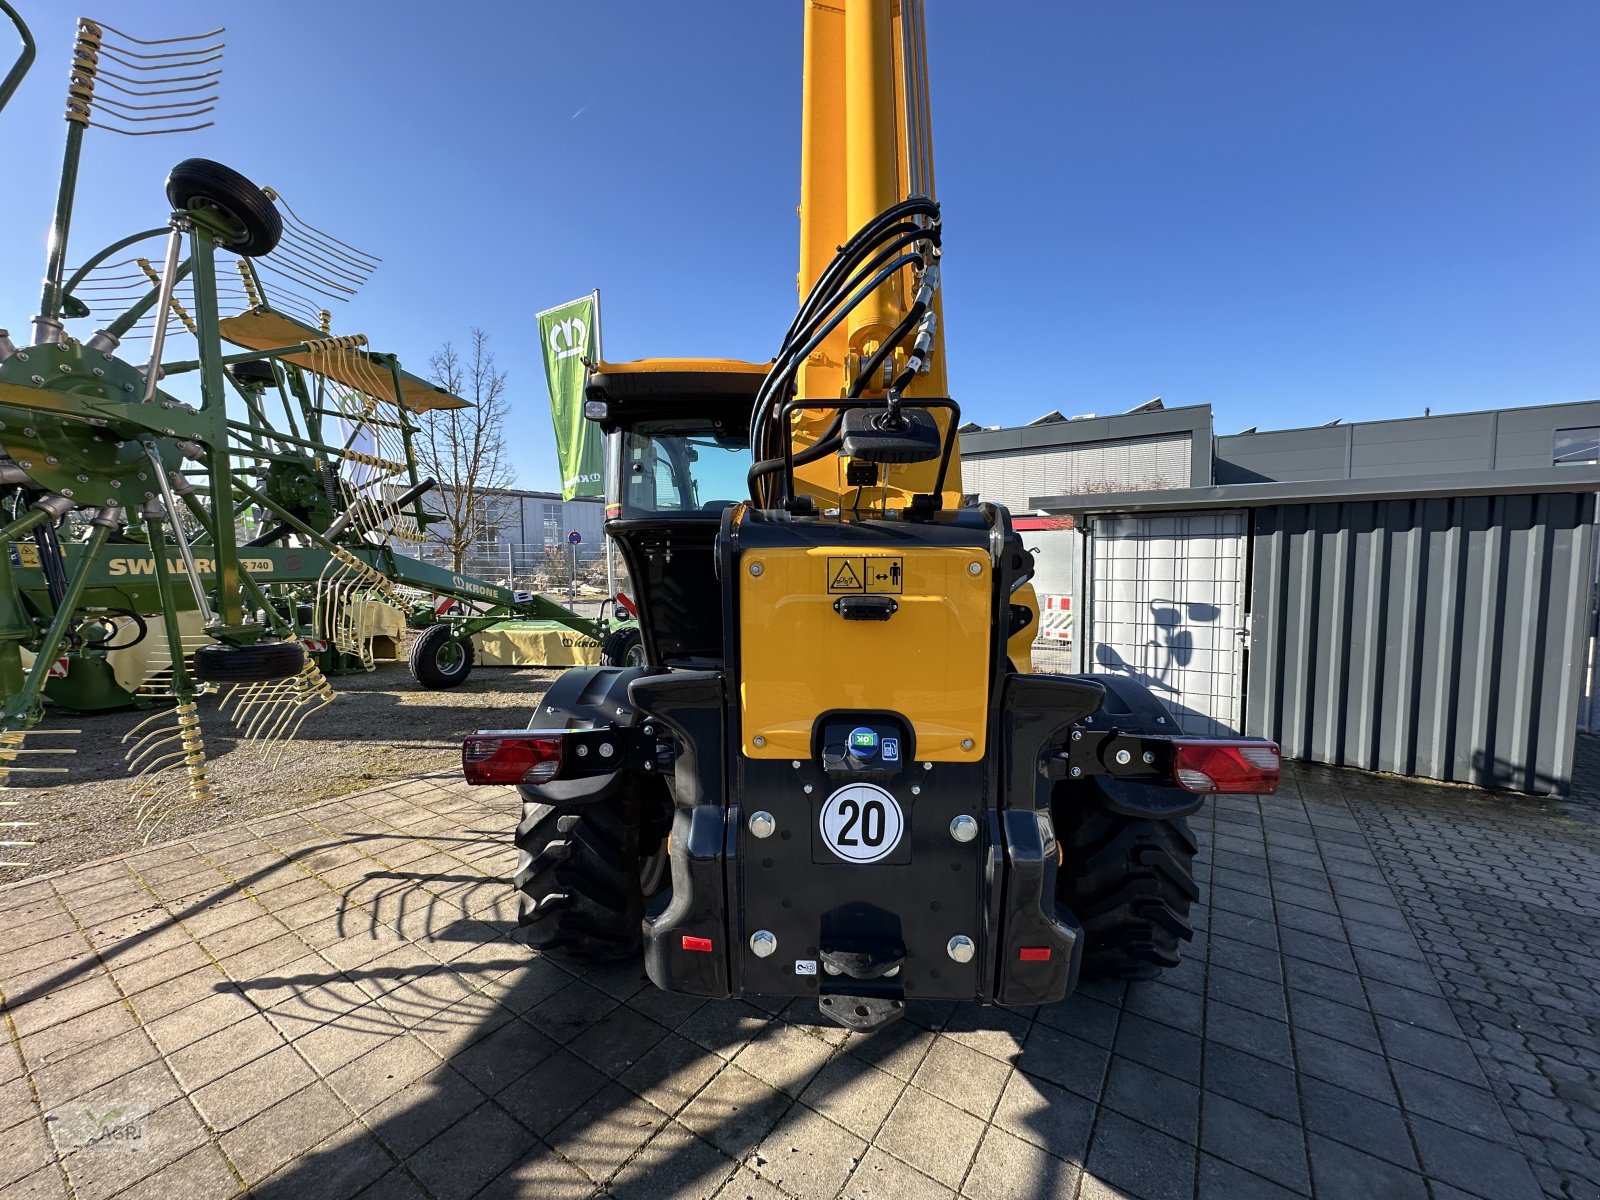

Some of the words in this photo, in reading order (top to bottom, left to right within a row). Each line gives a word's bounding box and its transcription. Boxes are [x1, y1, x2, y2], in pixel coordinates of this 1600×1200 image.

[109, 558, 217, 575] SWDR
[251, 561, 269, 569] 740
[465, 582, 498, 598] KRONE
[574, 640, 605, 648] KRON
[856, 735, 870, 743] OK
[837, 799, 885, 847] 20
